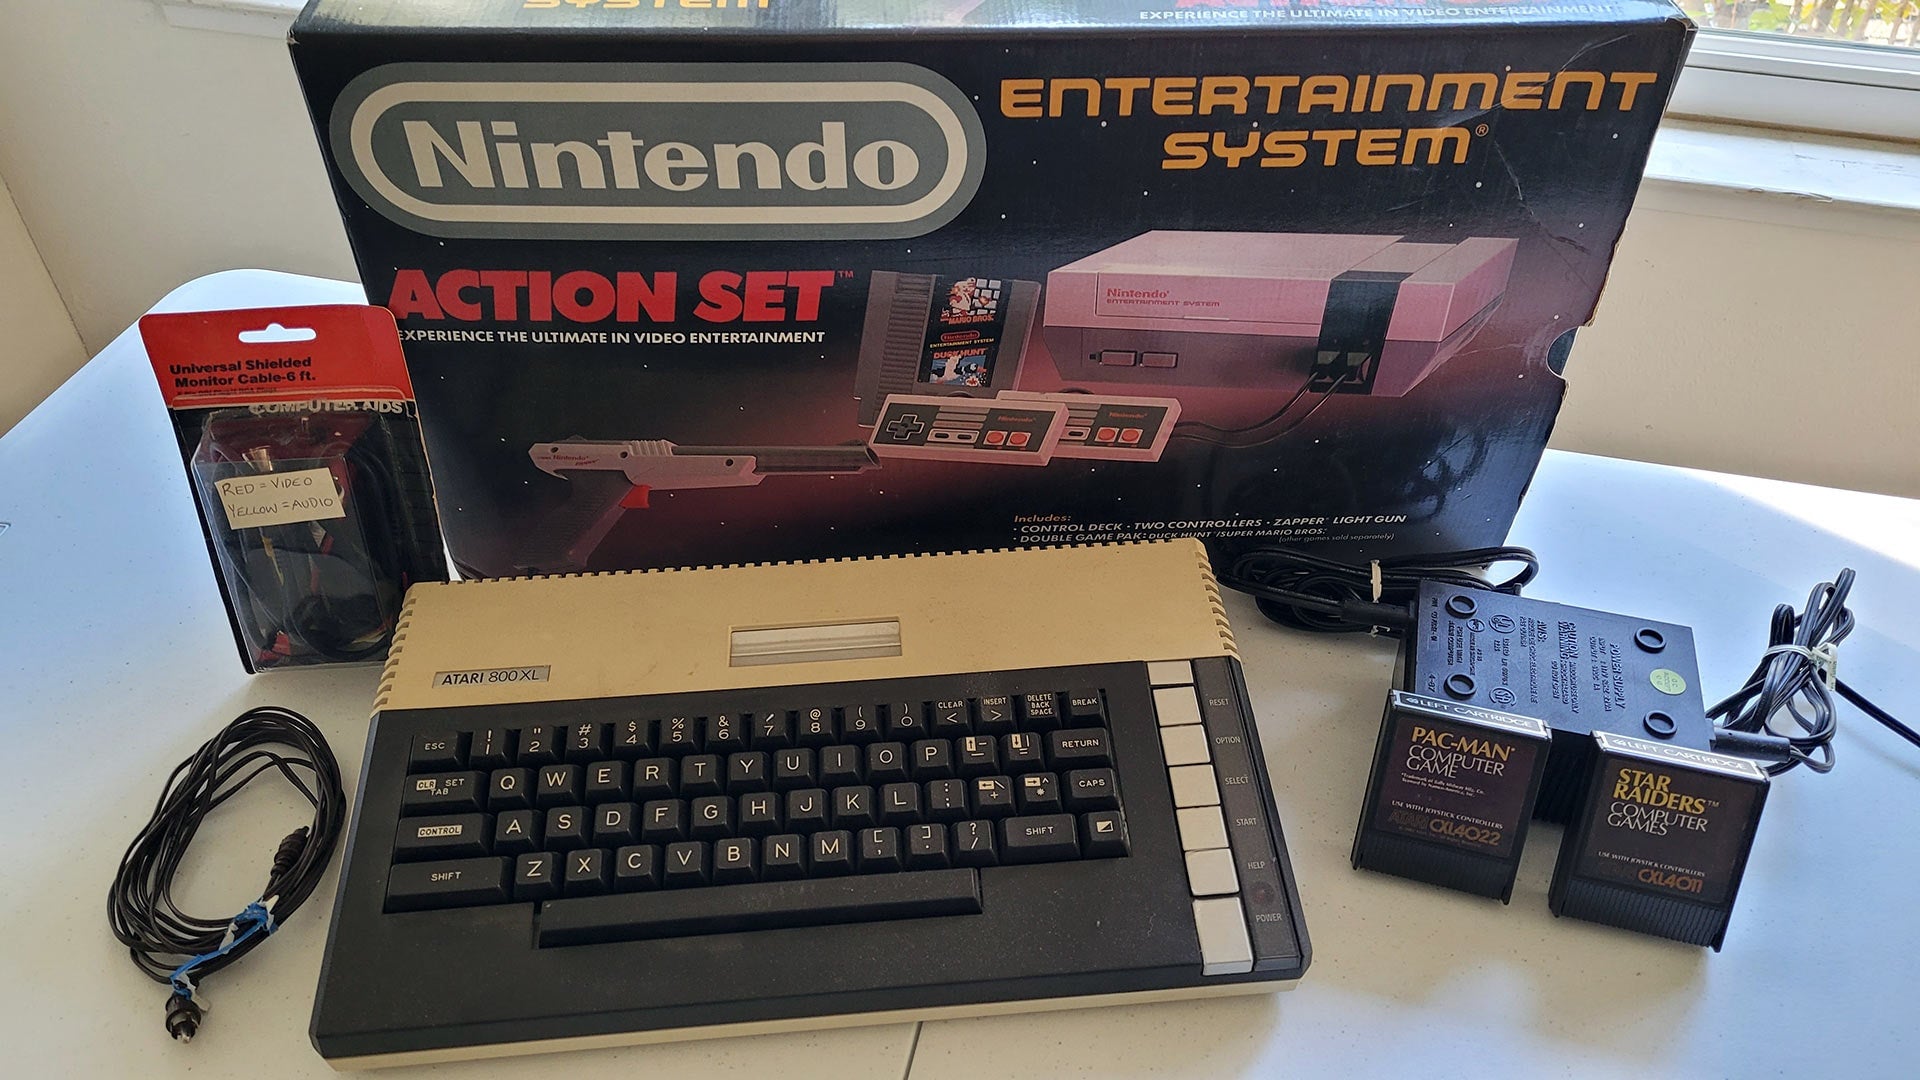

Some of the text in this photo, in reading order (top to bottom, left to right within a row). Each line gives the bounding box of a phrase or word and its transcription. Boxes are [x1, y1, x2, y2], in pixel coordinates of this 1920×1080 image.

[1140, 5, 1613, 20] EXPERIENCE THE ULTIMATE IN VIDEO ENTERTAINMENT
[1001, 72, 1657, 119] ENTERTAINMENT
[402, 120, 920, 192] Nintendo
[388, 269, 675, 323] ACTION
[1107, 288, 1167, 298] Nintendo
[498, 331, 527, 342] THE
[532, 332, 607, 343] ULTIMATE
[611, 333, 630, 343] IN
[634, 333, 686, 343] VIDEO
[690, 332, 825, 343] ENTERTAINMENT
[170, 357, 311, 375] Universal Shielded
[175, 371, 316, 387] Monitor Cable-6 ft.
[364, 400, 402, 413] AIDS
[222, 482, 254, 496] RED
[271, 476, 313, 489] VIDEO
[228, 503, 278, 518] YELLOW
[292, 498, 333, 510] AUDIO
[1015, 514, 1071, 522] Includes:
[1021, 524, 1085, 533] CONTROL
[1088, 523, 1122, 531] DECK
[1168, 519, 1262, 530] CONTROLLERS
[1273, 518, 1324, 526] ZAPPER
[1333, 516, 1372, 524] LIGHT
[1374, 515, 1406, 523] GUN
[1020, 534, 1073, 542] DOUBLE
[1076, 533, 1114, 541] GAME
[1117, 532, 1146, 540] PAK:
[442, 669, 539, 685] ATARI 800XL
[938, 700, 963, 709] CLEAR
[983, 697, 1007, 705] INSERT
[1027, 694, 1052, 702] DELETE
[1031, 701, 1050, 709] BACK
[1072, 698, 1098, 706] BREAK
[1209, 698, 1229, 706] RESET
[1030, 708, 1052, 716] SPACE
[1420, 699, 1533, 728] LEFT CARTRIDGE
[763, 725, 774, 736] 7
[810, 722, 821, 733] 8
[855, 719, 866, 730] 9
[625, 730, 637, 745] 4
[672, 731, 683, 742] 5
[718, 725, 730, 740] 6
[424, 742, 445, 751] ESC
[528, 740, 540, 753] 2
[578, 737, 589, 749] 3
[1062, 739, 1099, 748] RETURN
[1216, 736, 1240, 745] OPTION
[1412, 727, 1511, 762] PAC-MAN
[1628, 741, 1657, 752] LEFT
[837, 752, 841, 767] I
[879, 749, 893, 764] O
[925, 746, 938, 761] P
[1409, 745, 1505, 776] COMPUTER
[694, 762, 706, 777] T
[740, 759, 754, 774] Y
[786, 755, 799, 770] U
[1407, 756, 1457, 778] GAME
[546, 771, 567, 787] W
[597, 768, 611, 783] E
[645, 765, 659, 780] R
[418, 778, 464, 789] CLR SET
[500, 775, 515, 790] Q
[1079, 778, 1105, 788] CAPS
[1225, 776, 1249, 785] SELECT
[1618, 769, 1671, 792] STAR
[431, 787, 448, 796] TAB
[893, 791, 907, 806] L
[751, 800, 766, 815] H
[800, 796, 812, 812] J
[846, 793, 860, 810] K
[606, 810, 621, 826] D
[655, 807, 669, 823] F
[703, 804, 718, 819] G
[1406, 802, 1424, 811] WITH
[1425, 806, 1455, 819] JOYSTICK
[1456, 814, 1503, 829] CONTROLLERS
[1611, 801, 1708, 832] COMPUTER
[505, 819, 522, 834] A
[557, 814, 571, 829] S
[1237, 818, 1256, 826] START
[1608, 813, 1668, 836] GAMES
[418, 826, 461, 836] CONTROL
[1026, 826, 1053, 835] SHIFT
[1429, 819, 1501, 846] CXL4022
[727, 845, 741, 862] B
[775, 842, 789, 858] N
[821, 838, 839, 855] M
[577, 856, 591, 873] X
[627, 852, 642, 869] C
[676, 849, 693, 866] V
[1248, 861, 1265, 869] HELP
[1599, 851, 1705, 877] USE WITH JOYSTICK CONTROLLERS
[526, 860, 543, 877] Z
[431, 872, 461, 881] SHIFT
[1256, 913, 1282, 922] POWER
